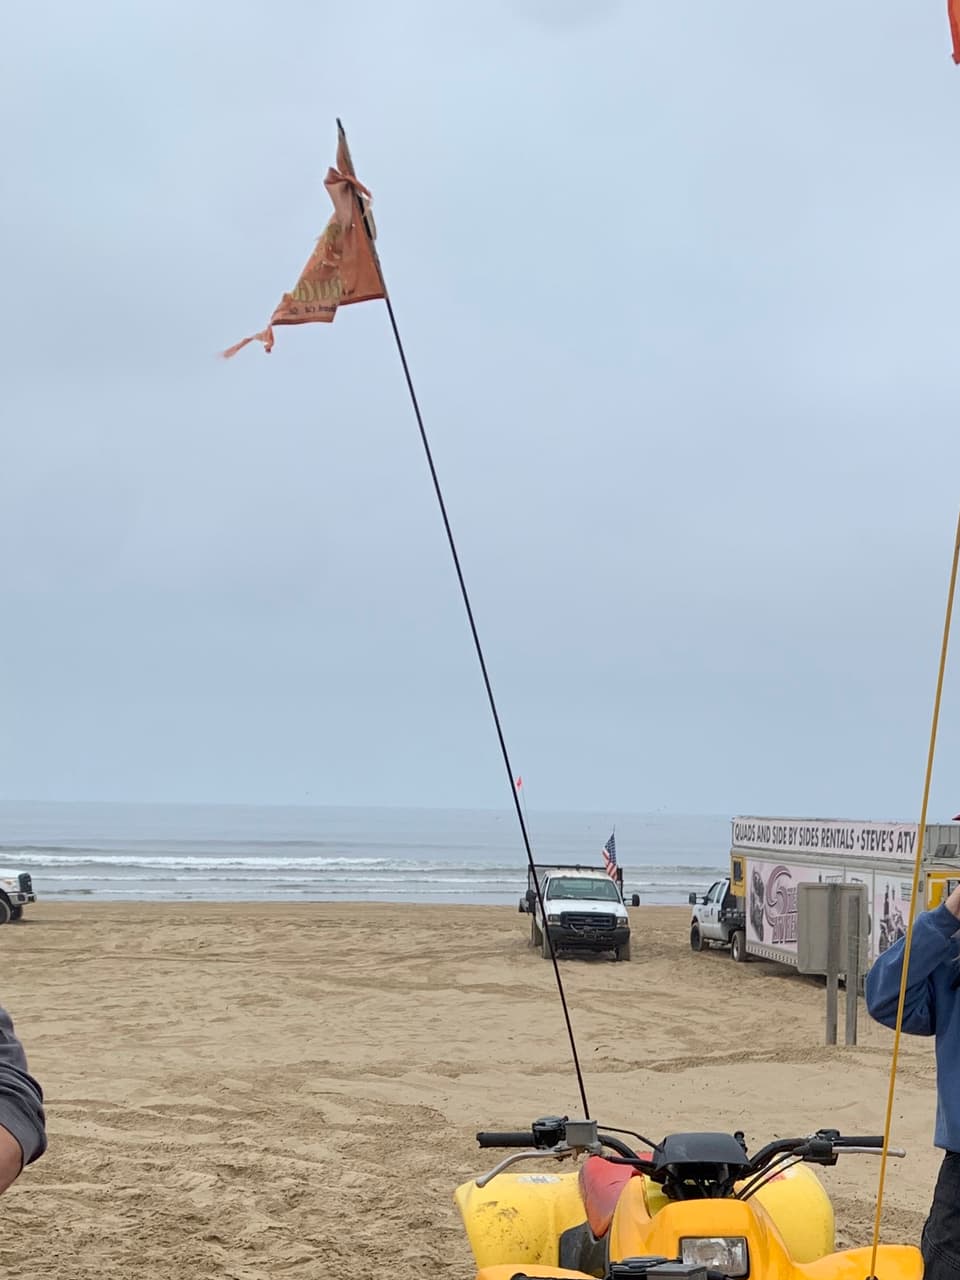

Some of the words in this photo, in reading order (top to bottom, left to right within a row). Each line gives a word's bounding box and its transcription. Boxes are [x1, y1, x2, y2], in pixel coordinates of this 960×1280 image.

[734, 823, 756, 842] QUADS
[756, 825, 771, 843] AND
[772, 825, 787, 845] SIDE
[789, 827, 797, 846] BY
[799, 827, 819, 848] SIDES
[821, 828, 855, 850] RENTALS
[860, 829, 894, 853] STEVE'S
[896, 831, 916, 853] ATV
